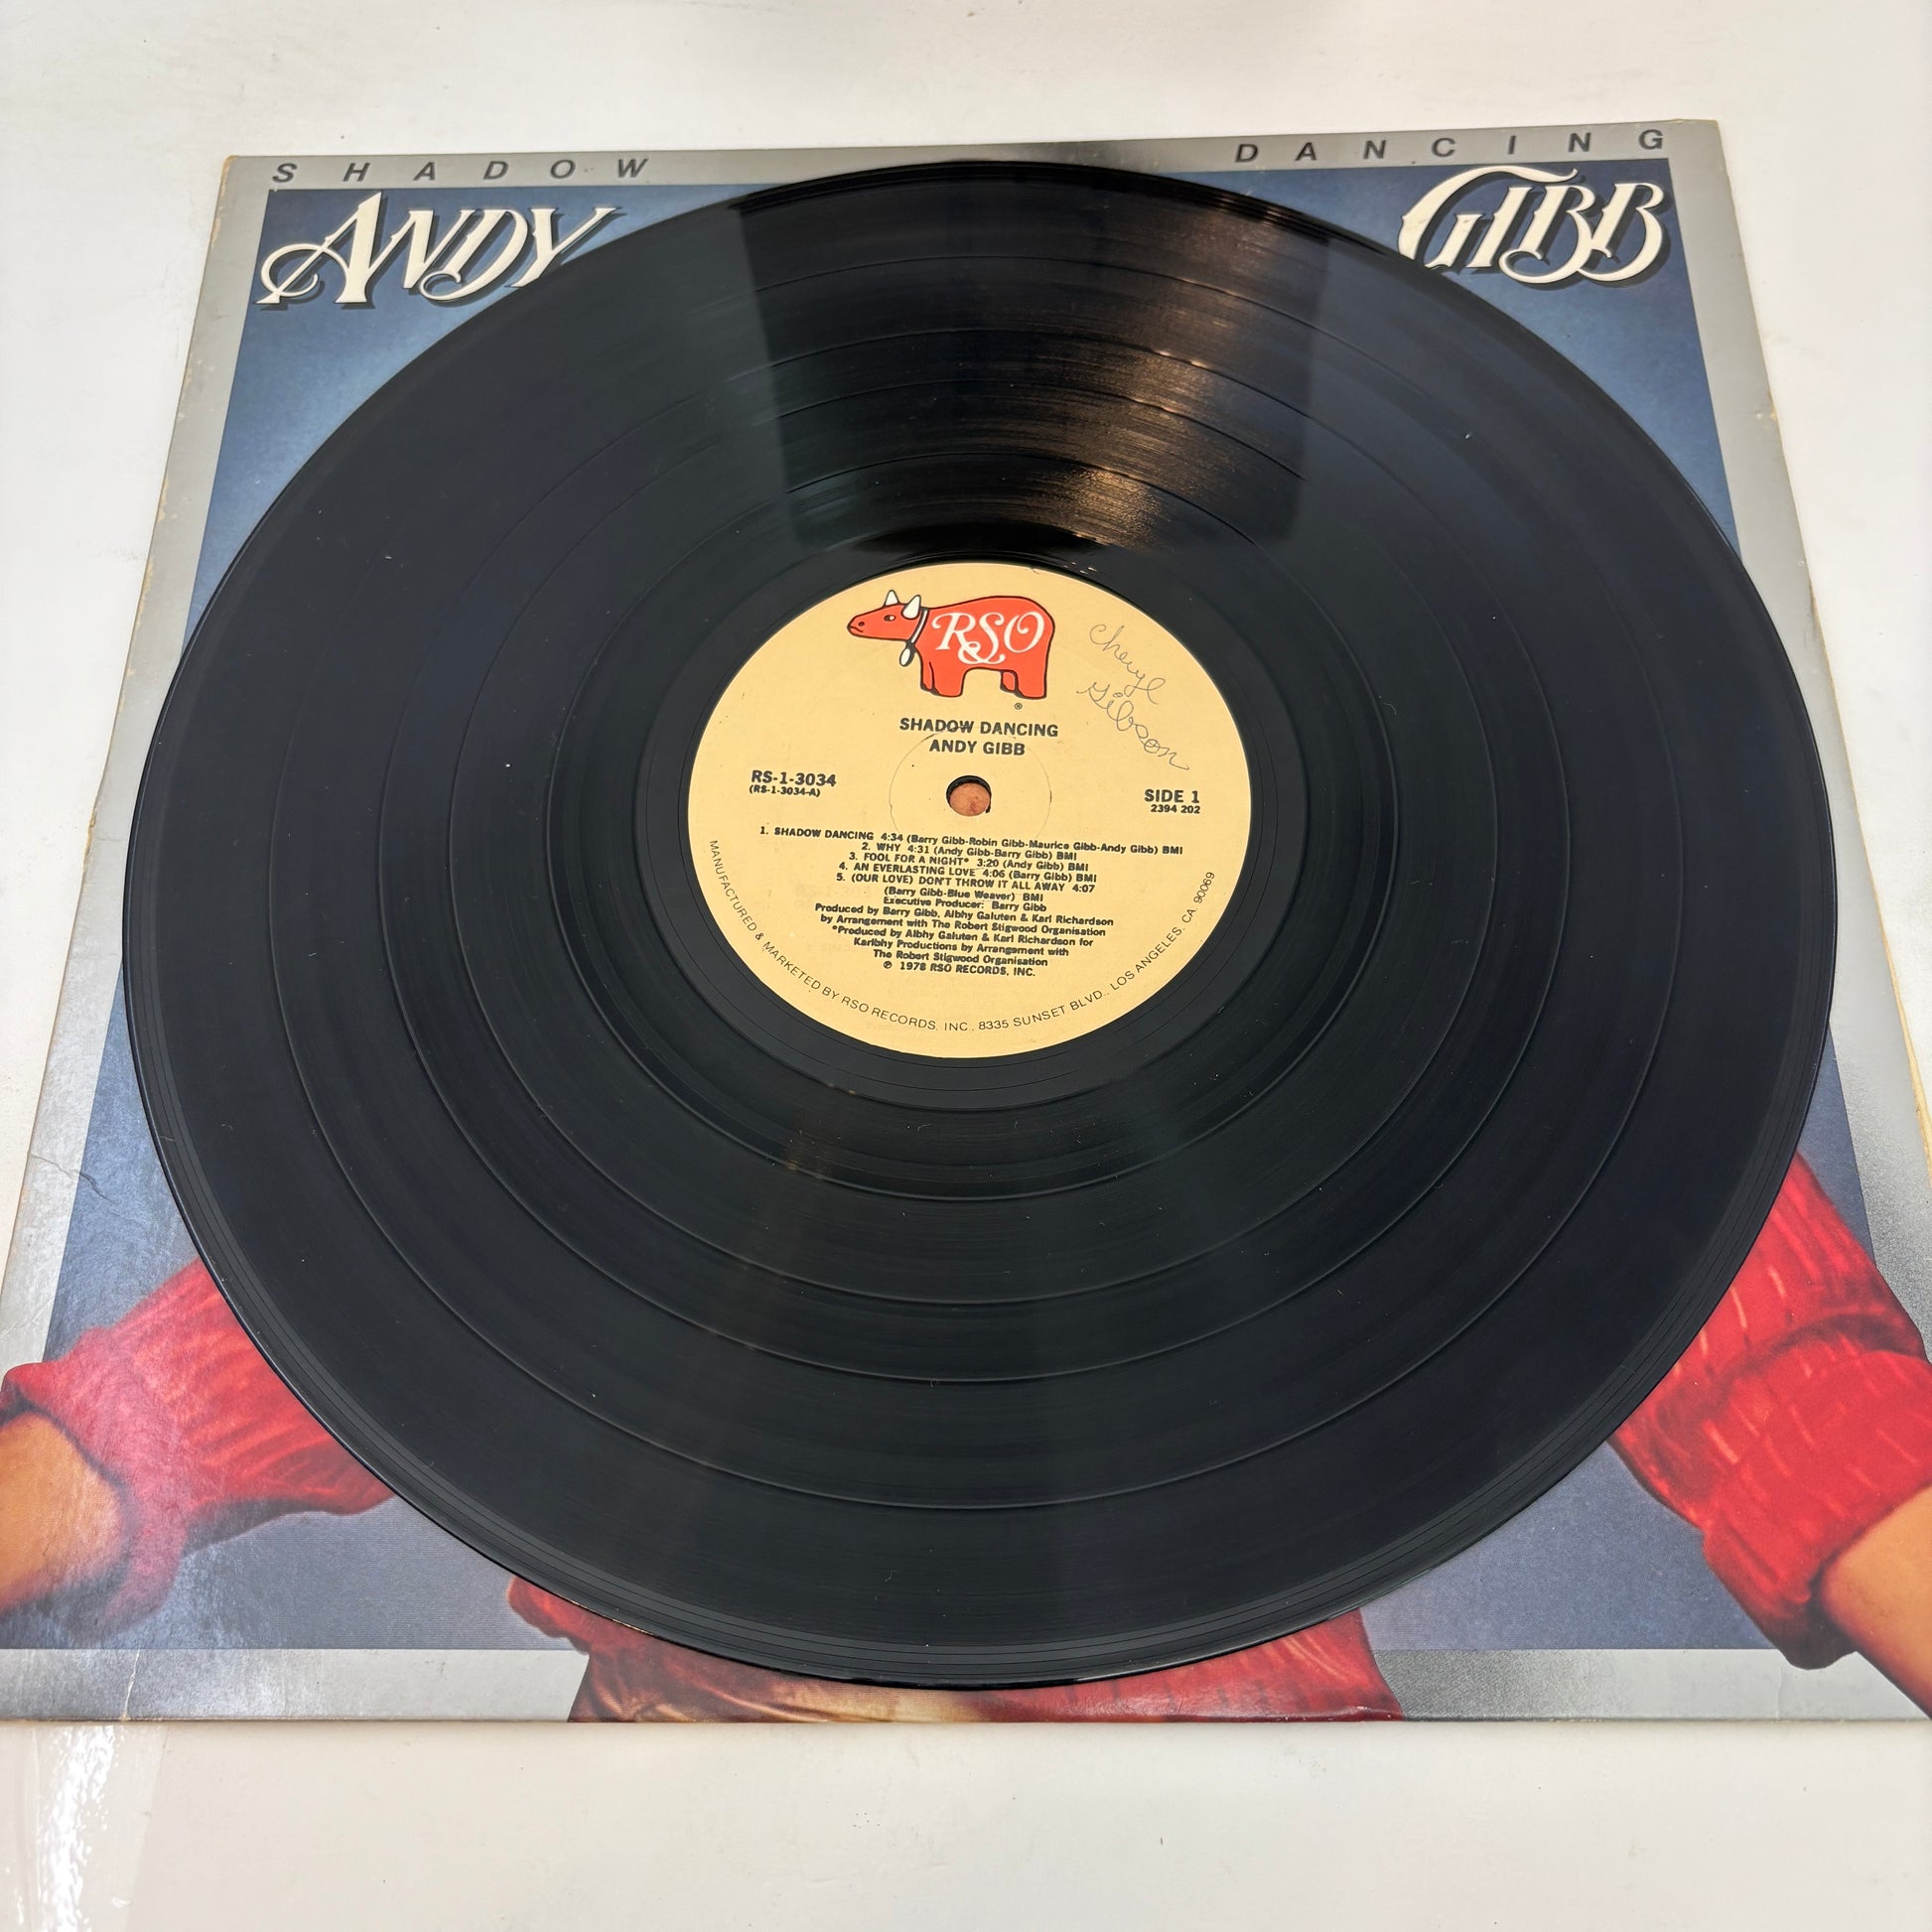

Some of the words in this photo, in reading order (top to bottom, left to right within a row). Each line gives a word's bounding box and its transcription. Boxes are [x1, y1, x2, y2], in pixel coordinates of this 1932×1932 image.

[272, 158, 649, 184] SHADOW
[1234, 129, 1665, 163] DANCING
[255, 190, 619, 304] ANDY
[1397, 165, 1664, 284] GIBB
[931, 611, 1044, 665] RSO
[899, 718, 974, 734] SHADOW
[979, 721, 1058, 738] DANCING
[1076, 682, 1189, 770] Gibson
[929, 740, 978, 754] ANDY
[983, 742, 1026, 756] GIBB
[751, 769, 837, 787] RS-1-3034
[749, 784, 821, 797] (RS-1-3034-A)
[1144, 788, 1184, 803] SIDE
[1191, 790, 1199, 803] 1
[1151, 804, 1177, 813] 2394
[1180, 805, 1200, 814] 202
[759, 826, 768, 835] 1.
[774, 826, 822, 838] SHADOW
[825, 830, 875, 840] DANCING
[880, 832, 903, 842] 4:34
[906, 834, 938, 845] (Barry
[941, 835, 997, 847] Gibb-Robin
[1001, 839, 1070, 850] Gibb-Maurice
[1072, 842, 1127, 854] Gibb-Andy
[1130, 845, 1159, 855] Gibb)
[1162, 846, 1183, 855] BMI
[862, 842, 871, 851] 2.
[876, 843, 900, 852] WHY
[907, 845, 929, 855] 4:31
[933, 846, 963, 857] (Andy
[967, 848, 1022, 860] Gibb-Barry
[1025, 850, 1052, 860] Gibb)
[1056, 851, 1077, 861] BMI
[849, 851, 858, 861] 3.
[864, 853, 891, 863] FOOL
[894, 854, 915, 864] FOR
[918, 855, 926, 864] A
[976, 858, 1000, 868] 3:20
[1002, 859, 1033, 871] (Andy
[1035, 861, 1064, 872] Gibb)
[1067, 862, 1089, 872] BMI
[839, 862, 848, 871] 4.
[854, 862, 870, 872] AN
[873, 863, 945, 876] EVERLASTING
[948, 867, 976, 877] LOVE
[982, 869, 1006, 878] 4:06
[1009, 870, 1040, 882] (Barry
[1043, 872, 1072, 883] Gibb)
[1076, 874, 1097, 883] BMI
[836, 873, 845, 882] 5.
[851, 874, 879, 884] (OUR
[883, 875, 913, 886] LOVE)
[918, 876, 952, 887] DON'T
[955, 878, 994, 890] THROW
[998, 880, 1009, 889] IT
[1011, 881, 1031, 891] ALL
[1035, 882, 1065, 892] AWAY
[1071, 884, 1096, 894] 4:07
[884, 887, 916, 897] (Barry
[919, 888, 971, 898] Gibb-Blue
[974, 890, 1016, 901] Weaver)
[1023, 893, 1043, 901] BMI
[884, 897, 931, 906] Executive
[935, 898, 984, 909] Producer:
[991, 901, 1020, 912] Barry
[1023, 902, 1047, 912] Gibb
[814, 903, 863, 914] Produced
[867, 904, 879, 915] by
[883, 906, 910, 917] Barry
[944, 909, 973, 921] Albhy
[977, 911, 1017, 922] Galuten
[1021, 913, 1029, 922] &
[1032, 913, 1052, 923] Karl
[1055, 915, 1114, 926] Richardson
[820, 914, 833, 924] by
[837, 915, 903, 927] Arrangement
[906, 917, 928, 927] with
[931, 918, 951, 929] The
[954, 921, 988, 931] Robert
[991, 922, 1037, 934] Stigwood
[1041, 925, 1106, 937] Organisation
[710, 840, 758, 931] MANUFACTURED
[755, 932, 764, 941] &
[763, 941, 821, 990] MARKETED
[821, 986, 840, 1000] BY
[842, 996, 869, 1013] RSO
[978, 1021, 1009, 1031] 8335
[1013, 1005, 1066, 1028] SUNSET
[1110, 970, 1136, 991] LOS
[1193, 872, 1215, 904] 90069
[890, 928, 902, 939] by
[905, 929, 934, 941] Albhy
[938, 930, 978, 942] Galuten
[981, 932, 990, 942] &
[993, 933, 1015, 943] Karl
[1018, 934, 1076, 947] Richardson
[1079, 937, 1093, 947] for
[897, 939, 958, 951] Productions
[961, 943, 973, 953] by
[976, 944, 1044, 956] Arrangement
[1047, 946, 1069, 956] with
[874, 949, 893, 959] The
[896, 950, 929, 961] Robert
[933, 952, 980, 964] Stigwood
[983, 955, 1048, 966] Organisation
[899, 961, 926, 971] 1978
[930, 963, 952, 973] RSO
[1014, 967, 1035, 977] INC.
